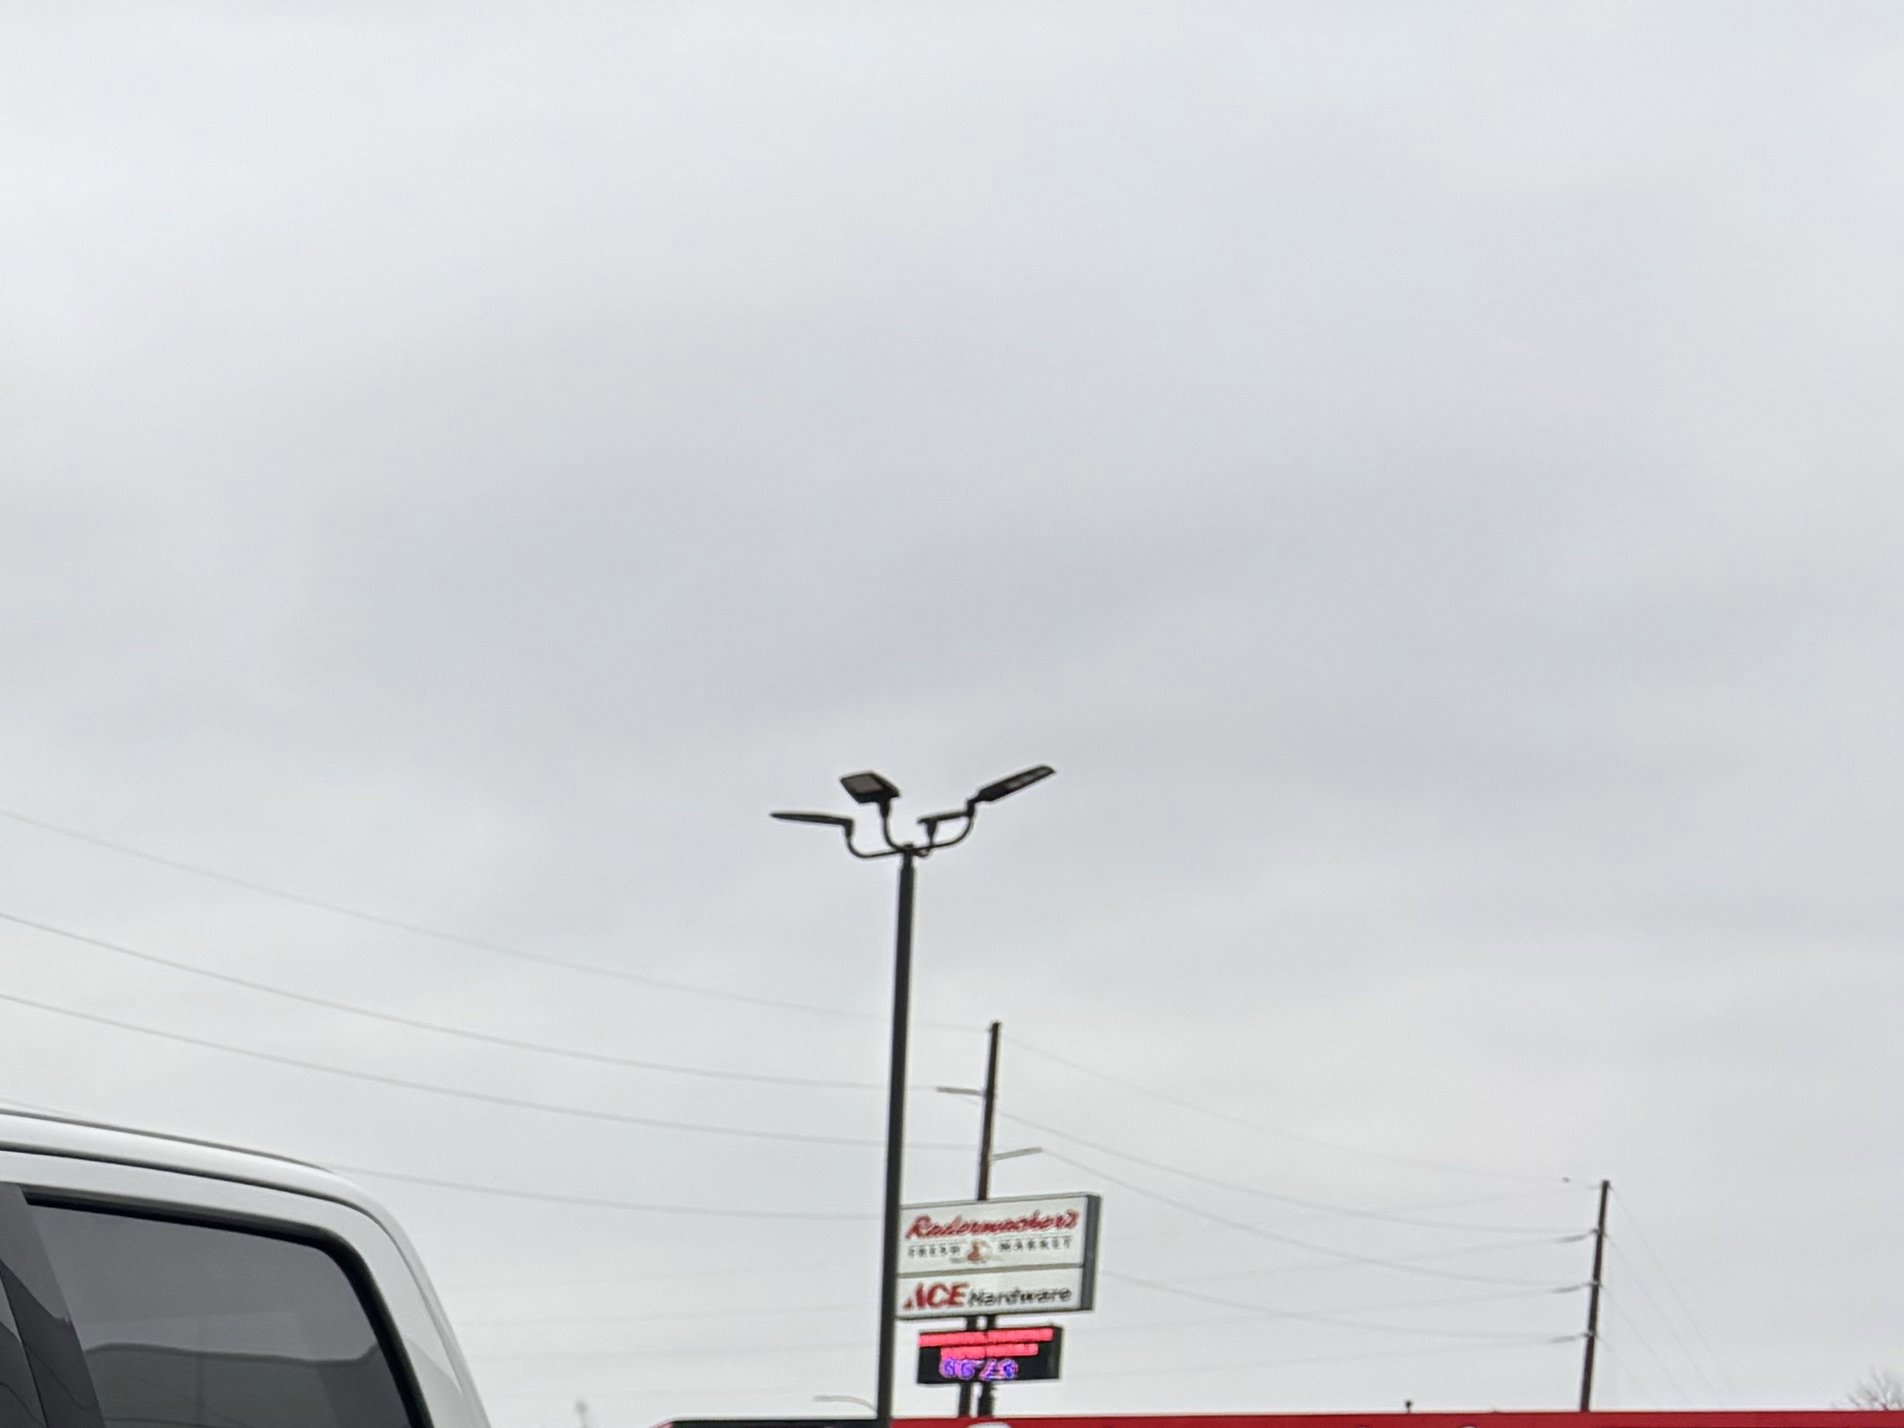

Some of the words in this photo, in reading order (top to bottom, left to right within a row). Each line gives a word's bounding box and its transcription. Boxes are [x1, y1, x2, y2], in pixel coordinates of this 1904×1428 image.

[997, 1236, 1073, 1252] MARKET
[903, 1281, 971, 1311] ACE
[968, 1286, 1073, 1308] Hardware
